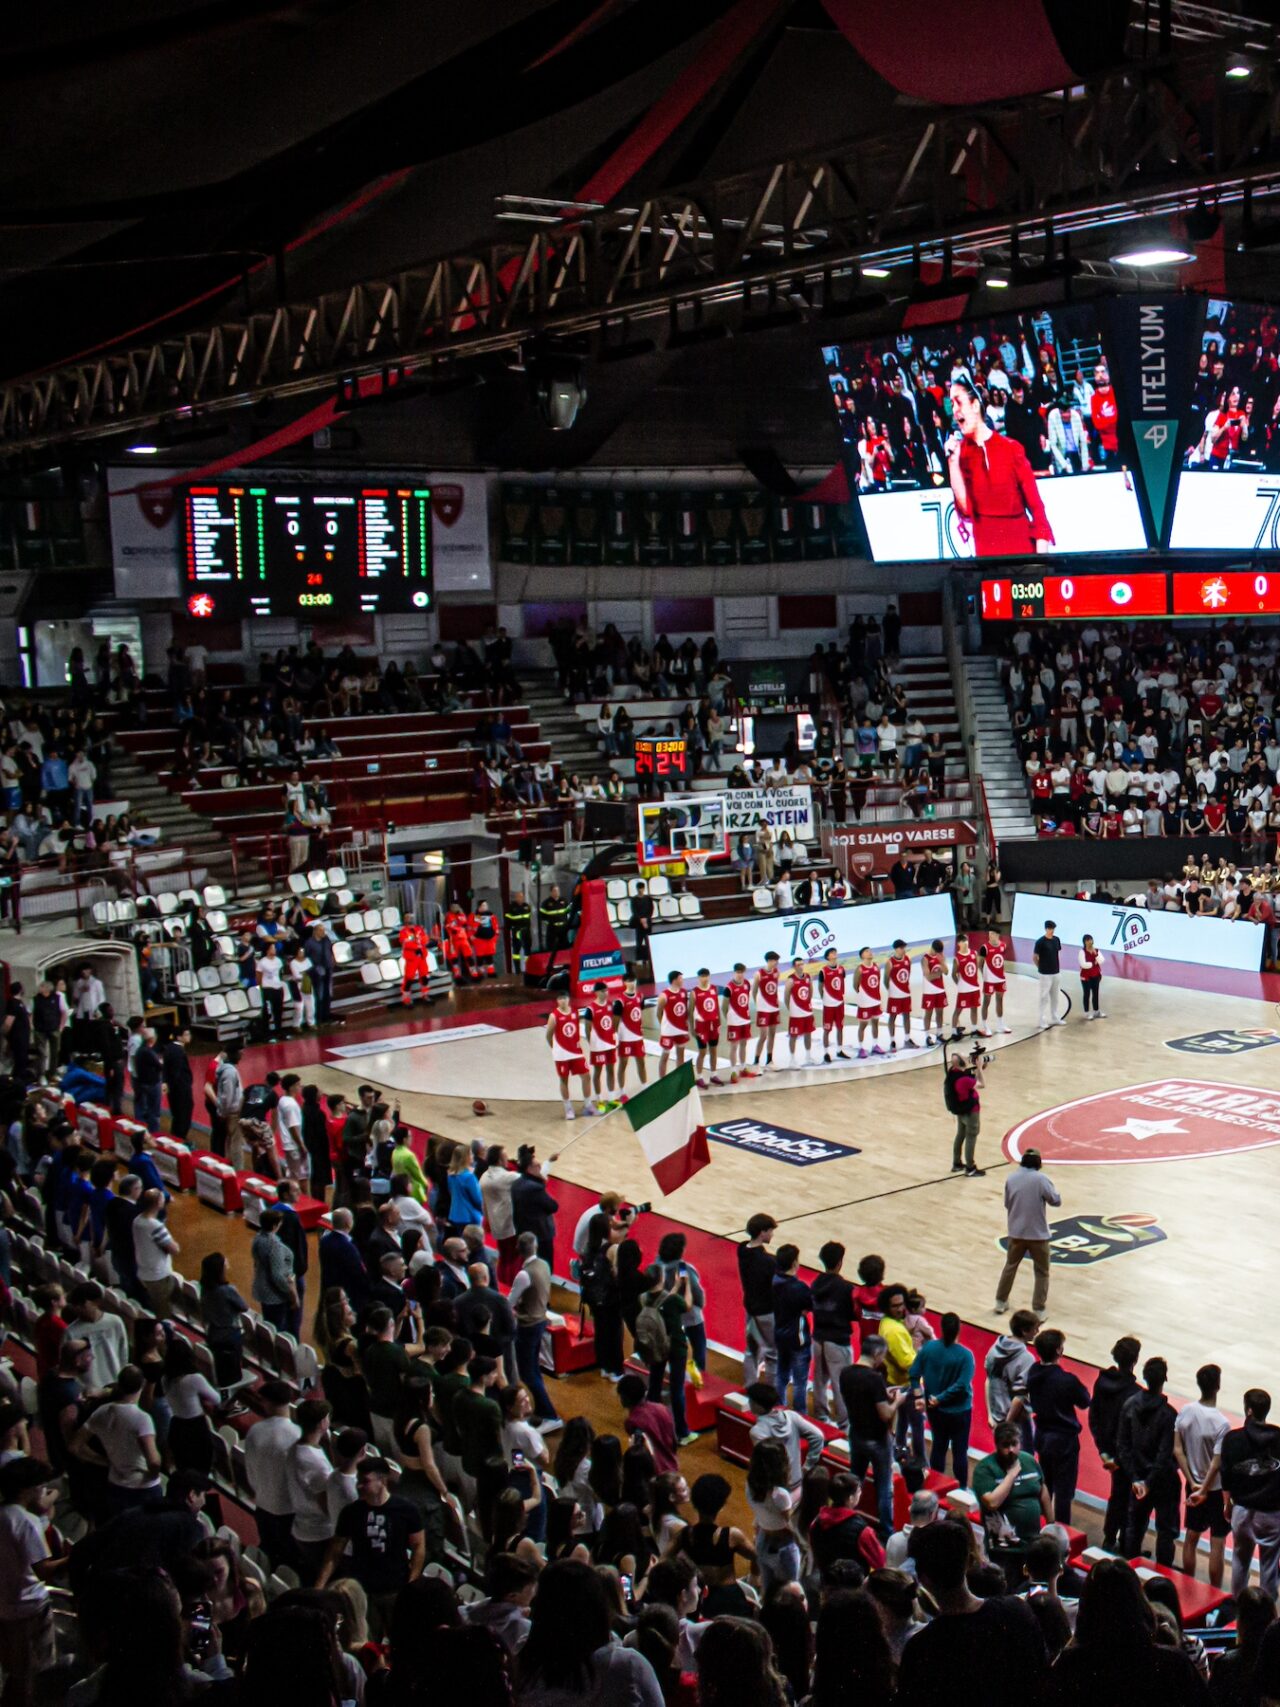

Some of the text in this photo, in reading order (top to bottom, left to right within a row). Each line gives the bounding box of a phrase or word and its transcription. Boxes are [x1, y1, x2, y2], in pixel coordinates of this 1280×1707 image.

[1139, 305, 1166, 412] ITELYUM
[287, 520, 299, 535] 0
[326, 520, 338, 535] 0
[307, 573, 323, 585] 24
[1255, 575, 1268, 595] 0
[993, 583, 1001, 602] 0
[1011, 583, 1043, 599] 03:00
[1061, 579, 1074, 599] 0
[299, 593, 333, 605] 03:00
[1021, 605, 1033, 616] 24
[656, 753, 686, 774] 24
[744, 800, 763, 810] CON
[766, 799, 774, 808] IL
[767, 809, 808, 826] STEIN
[859, 832, 903, 845] SIAMO
[905, 828, 956, 842] VARESE
[810, 928, 820, 940] B
[1111, 910, 1147, 945] 70
[1131, 924, 1139, 936] B
[783, 917, 830, 956] 70
[1123, 933, 1151, 951] BELGO
[806, 933, 836, 958] BELGO
[583, 956, 613, 968] ITELYUM
[719, 1122, 843, 1159] UnipolSai
[1050, 1229, 1111, 1258] BA
